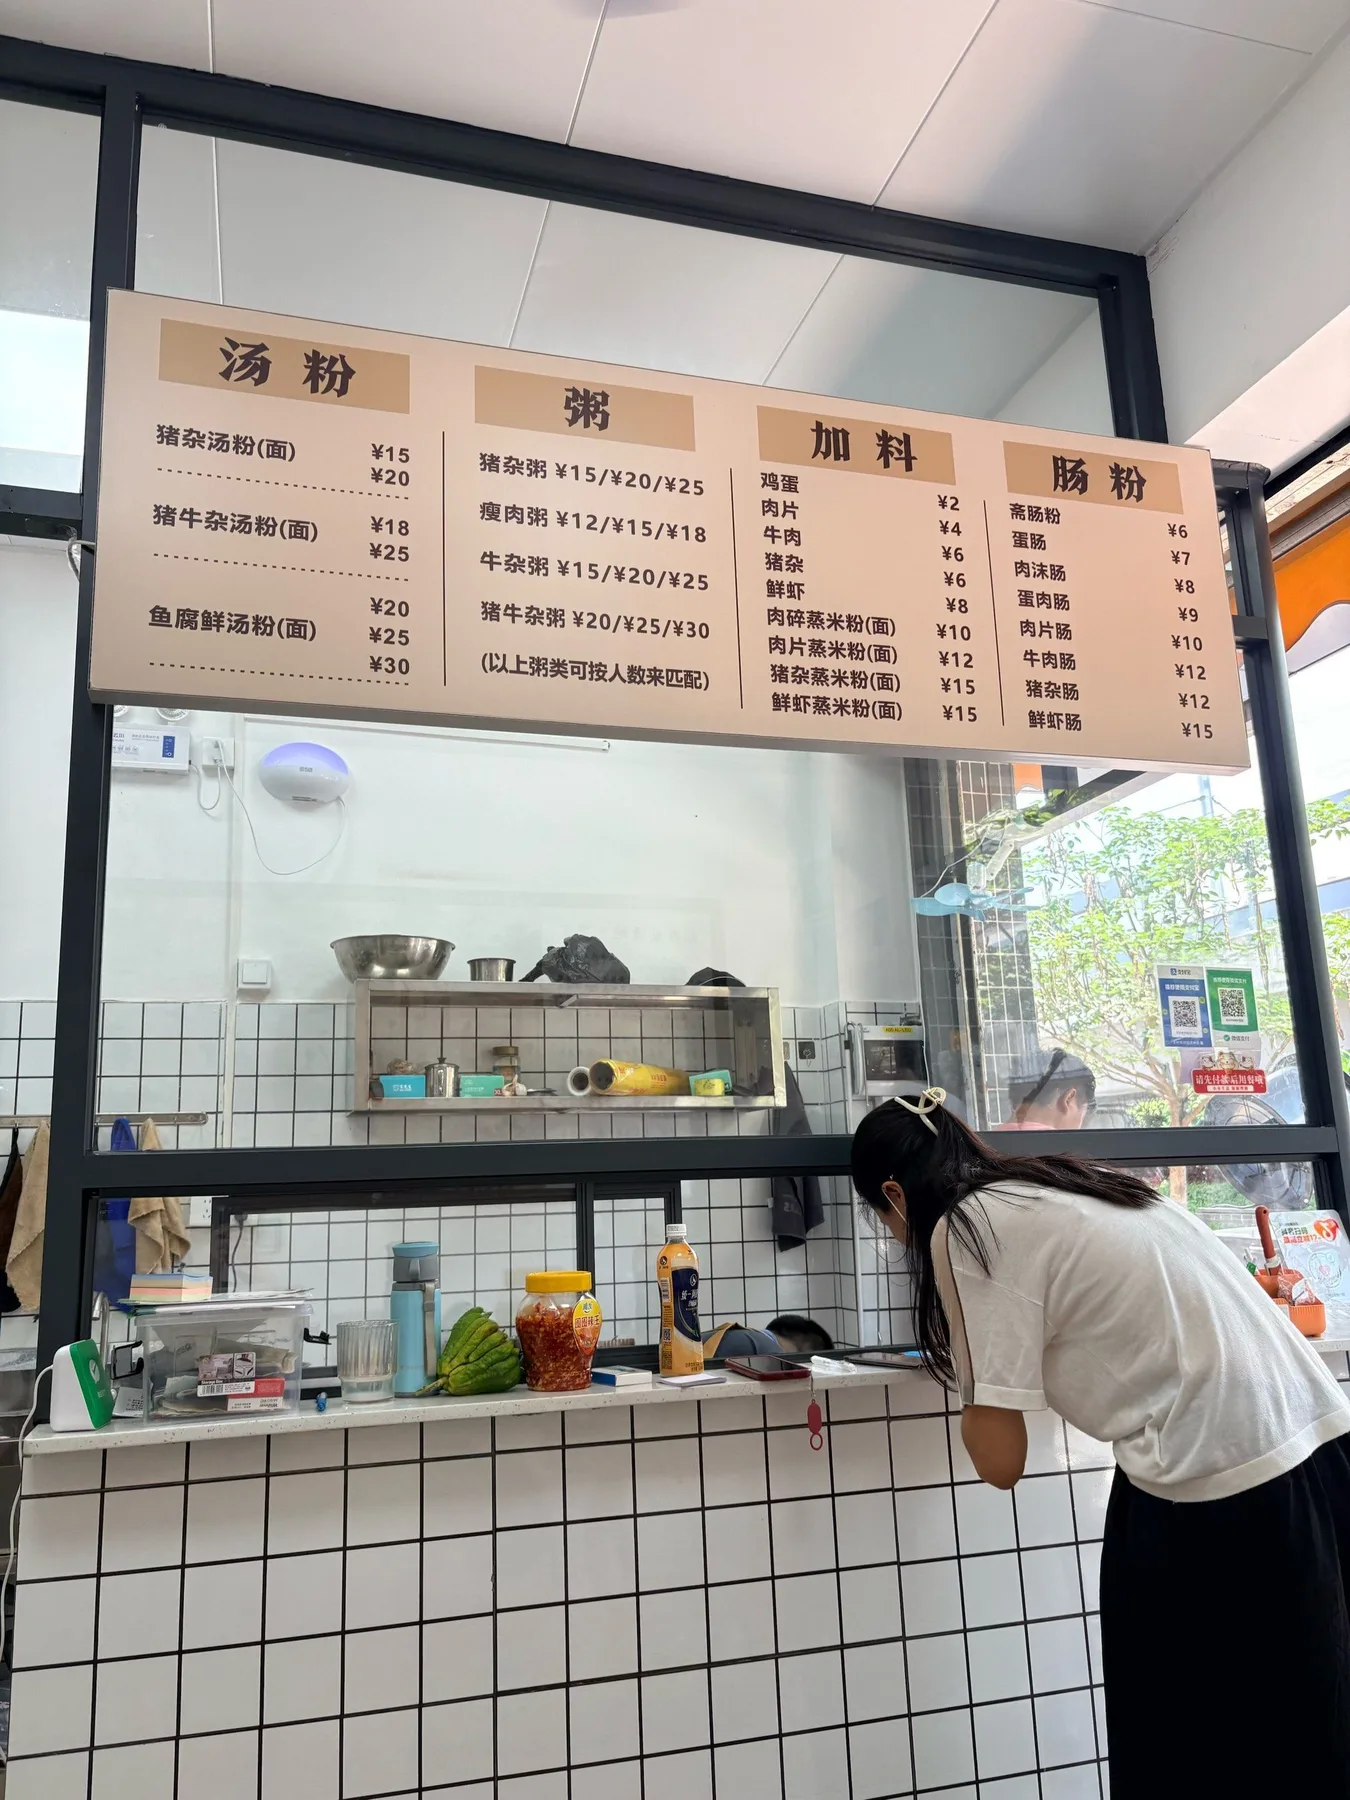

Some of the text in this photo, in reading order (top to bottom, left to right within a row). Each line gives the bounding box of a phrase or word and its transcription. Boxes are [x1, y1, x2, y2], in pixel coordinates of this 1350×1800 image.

[563, 386, 611, 432] 粥
[156, 424, 410, 464] 猪杂汤粉(面) ¥15
[371, 467, 410, 487] ¥20
[479, 452, 704, 496] 猪杂粥 ¥15/¥20/¥25
[760, 472, 960, 512] 鸡蛋 ¥2
[152, 503, 410, 543] 猪牛杂汤粉(面) ¥18
[479, 501, 707, 543] 瘦肉粥 ¥12/¥15/¥18
[761, 498, 962, 537] 肉片 ¥4
[1009, 502, 1188, 539] 斋肠粉 ¥6
[369, 542, 410, 562] ¥25
[763, 525, 964, 562] 牛肉 ¥6
[1011, 530, 1191, 566] 蛋肠 ¥7
[480, 550, 709, 591] 牛杂粥 ¥15/¥20/¥25
[764, 552, 967, 588] 猪杂 ¥6
[1014, 559, 1195, 594] 肉沫肠 ¥8
[370, 596, 410, 618] ¥20
[765, 578, 969, 614] 鲜虾 ¥8
[1017, 589, 1199, 623] 蛋肉肠 ¥9
[148, 604, 410, 646] 鱼腐鲜汤粉(面) ¥25
[480, 600, 710, 639] 猪牛杂粥 ¥20/¥25/¥30
[767, 607, 971, 641] 肉碎蒸米粉(面) ¥10
[1019, 618, 1203, 652] 肉片肠 ¥10
[369, 655, 410, 675] ¥30
[768, 635, 974, 669] 肉片蒸米粉(面) ¥12
[1023, 648, 1207, 681] 牛肉肠 ¥12
[481, 652, 710, 691] (以上粥类可按人数来匹配)
[770, 663, 976, 695] 猪杂蒸米粉(面) ¥15
[771, 691, 978, 723] 鲜虾蒸米粉(面) ¥15
[1025, 679, 1210, 710] 猪杂肠 ¥12
[1027, 709, 1213, 739] 鲜虾肠 ¥15
